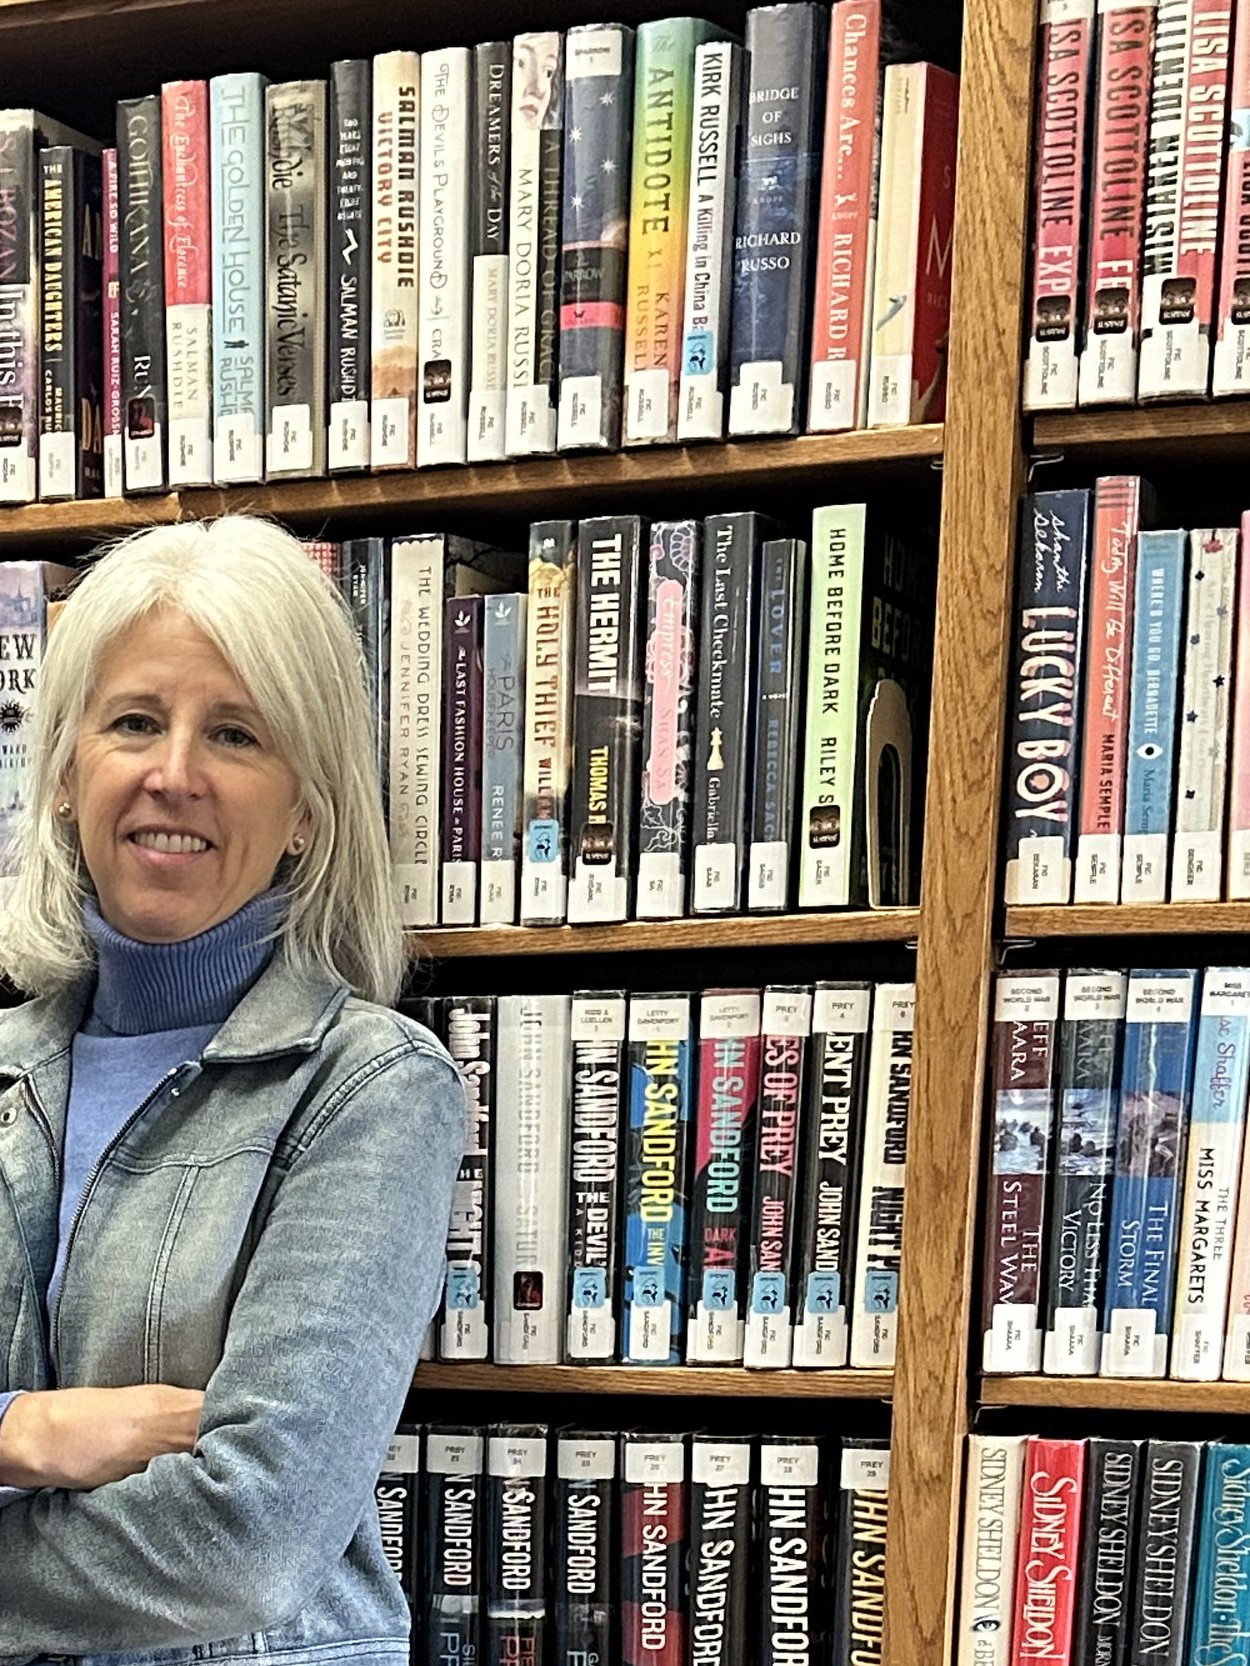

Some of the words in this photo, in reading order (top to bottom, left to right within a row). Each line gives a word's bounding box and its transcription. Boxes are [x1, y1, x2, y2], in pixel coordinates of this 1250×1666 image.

[701, 53, 723, 98] KIRK
[1191, 10, 1230, 75] LISA
[228, 88, 247, 143] THE
[397, 86, 415, 182] SALMAN
[641, 67, 674, 235] ANTIDOTE
[697, 106, 720, 186] RUSSELL
[377, 112, 392, 206] VICTORY
[1180, 85, 1225, 255] SCOTTOLINE
[43, 179, 65, 258] AMERICAN
[226, 154, 248, 243] GOLDEN
[377, 217, 392, 264] CITY
[397, 191, 414, 287] RUSHDIE
[735, 233, 801, 249] RICHARD
[741, 257, 790, 278] RUSSO
[44, 263, 64, 353] DAUGHTERS
[226, 252, 251, 333] HOUSE
[274, 253, 308, 328] Satanic
[279, 329, 306, 396] Verses
[590, 534, 621, 588] THE
[717, 525, 732, 563] The
[827, 529, 846, 579] HOME
[714, 568, 731, 610] Last
[825, 586, 844, 658] BEFORE
[535, 605, 561, 667] HOLY
[588, 593, 620, 694] HERMIT
[709, 614, 730, 718] Checkmate
[1017, 606, 1076, 726] LUCKY
[453, 663, 466, 695] LAST
[534, 675, 559, 748] THIEF
[822, 663, 842, 715] DARK
[453, 700, 466, 762] FASHION
[1100, 734, 1116, 775] MARIA
[453, 767, 466, 815] HOUSE
[1015, 740, 1071, 822] BOY
[1097, 780, 1114, 828] SEMPLE
[764, 1071, 796, 1103] OF
[641, 1083, 678, 1222] SANDFORD
[706, 1075, 744, 1212] SANDFORD
[760, 1109, 795, 1177] PREY
[818, 1095, 849, 1166] PREY
[1197, 1148, 1215, 1190] MISS
[1058, 1210, 1081, 1291] VICTORY
[1118, 1220, 1139, 1287] STORM
[1188, 1200, 1210, 1304] MARGARETS
[1031, 1471, 1077, 1559] SIDNEY
[1149, 1460, 1184, 1546] SIDNEY
[641, 1524, 666, 1650] SANDFORD
[1020, 1560, 1072, 1660] SHELDON
[1140, 1546, 1178, 1656] SHELDON
